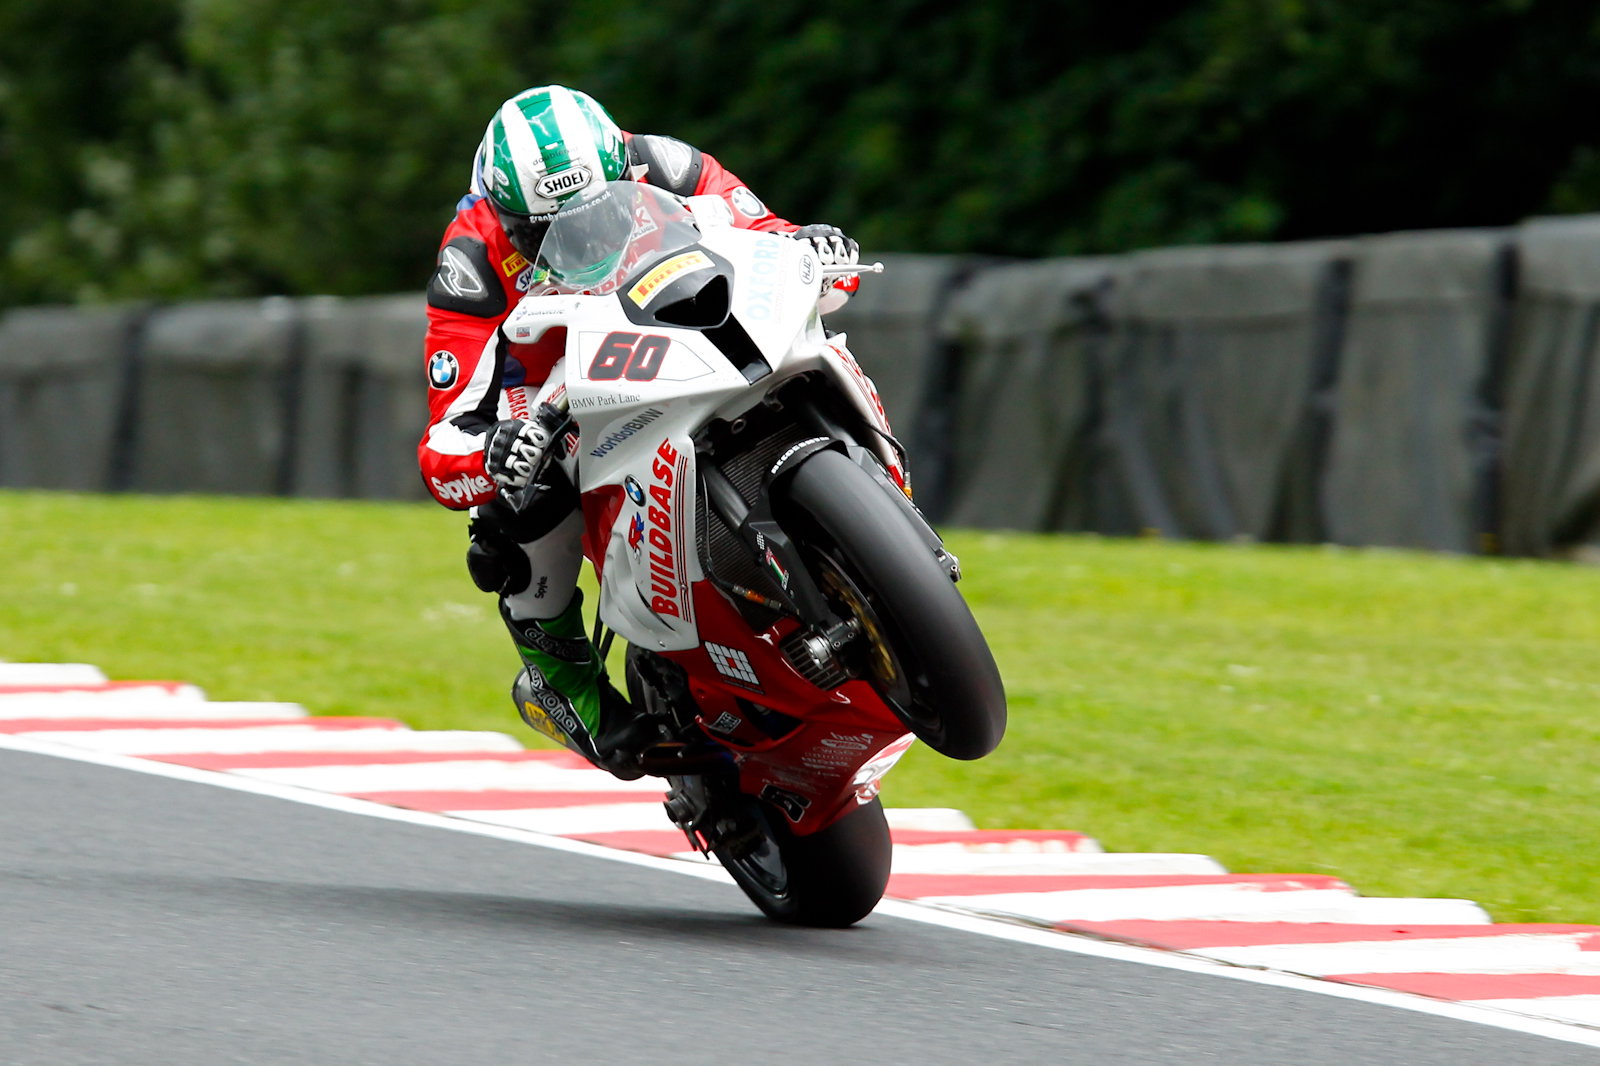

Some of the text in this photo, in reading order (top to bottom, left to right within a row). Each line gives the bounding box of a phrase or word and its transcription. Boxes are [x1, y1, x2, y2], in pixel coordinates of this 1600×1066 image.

[543, 171, 584, 194] SHOEI
[637, 255, 702, 297] PIRELLI
[588, 331, 671, 382] 60
[571, 393, 640, 409] BMW Park Lane
[431, 472, 494, 504] Spyke
[648, 437, 680, 619] BUILDBASE
[534, 576, 548, 599] Spyke
